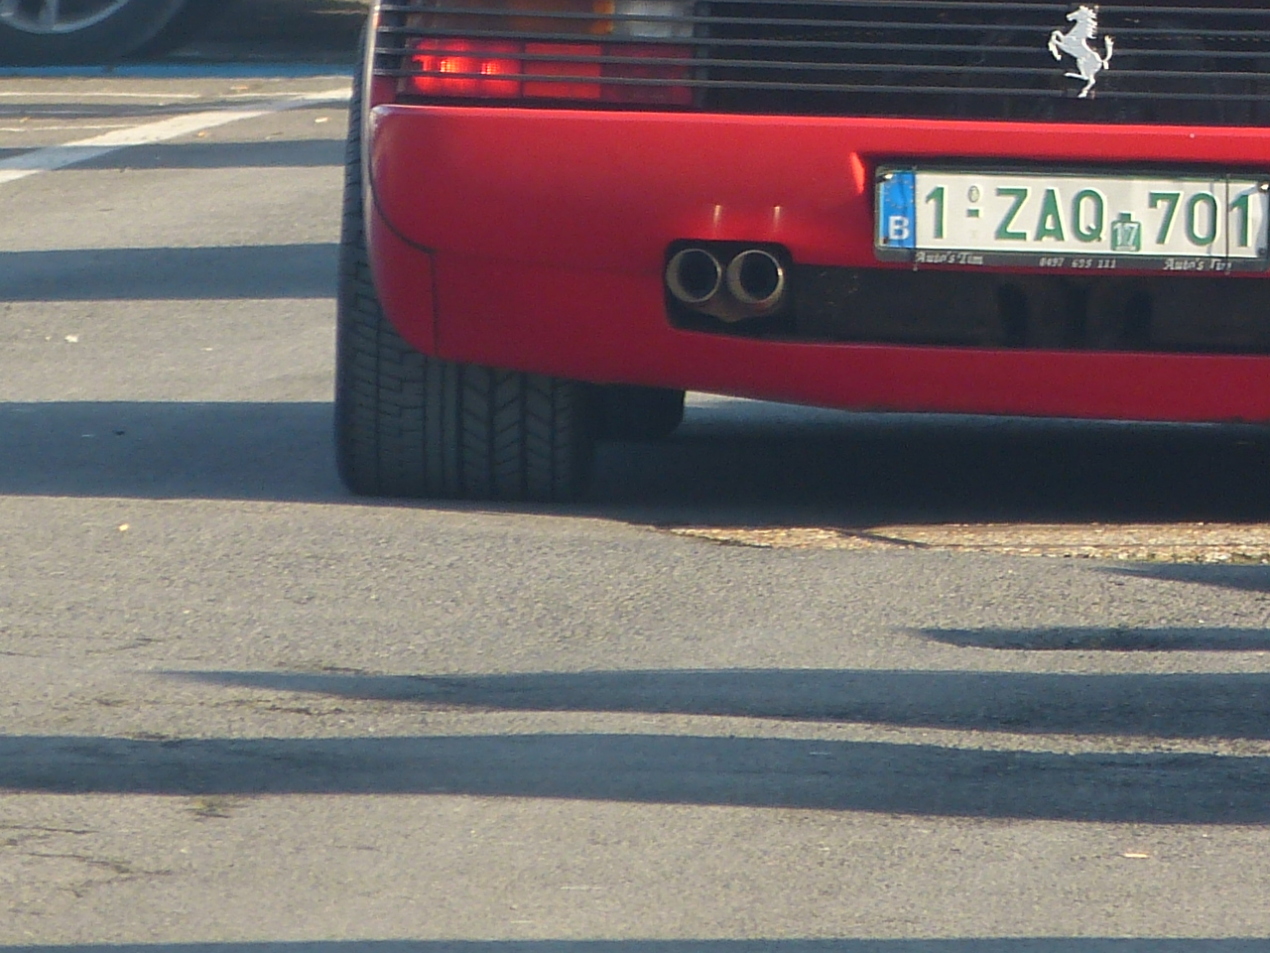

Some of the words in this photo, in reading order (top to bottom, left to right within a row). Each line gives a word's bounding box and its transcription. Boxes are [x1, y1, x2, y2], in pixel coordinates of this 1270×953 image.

[888, 215, 910, 240] B
[1112, 222, 1140, 246] 17
[915, 251, 955, 264] Auto's
[957, 252, 984, 265] Tim
[1163, 258, 1204, 271] Auto's
